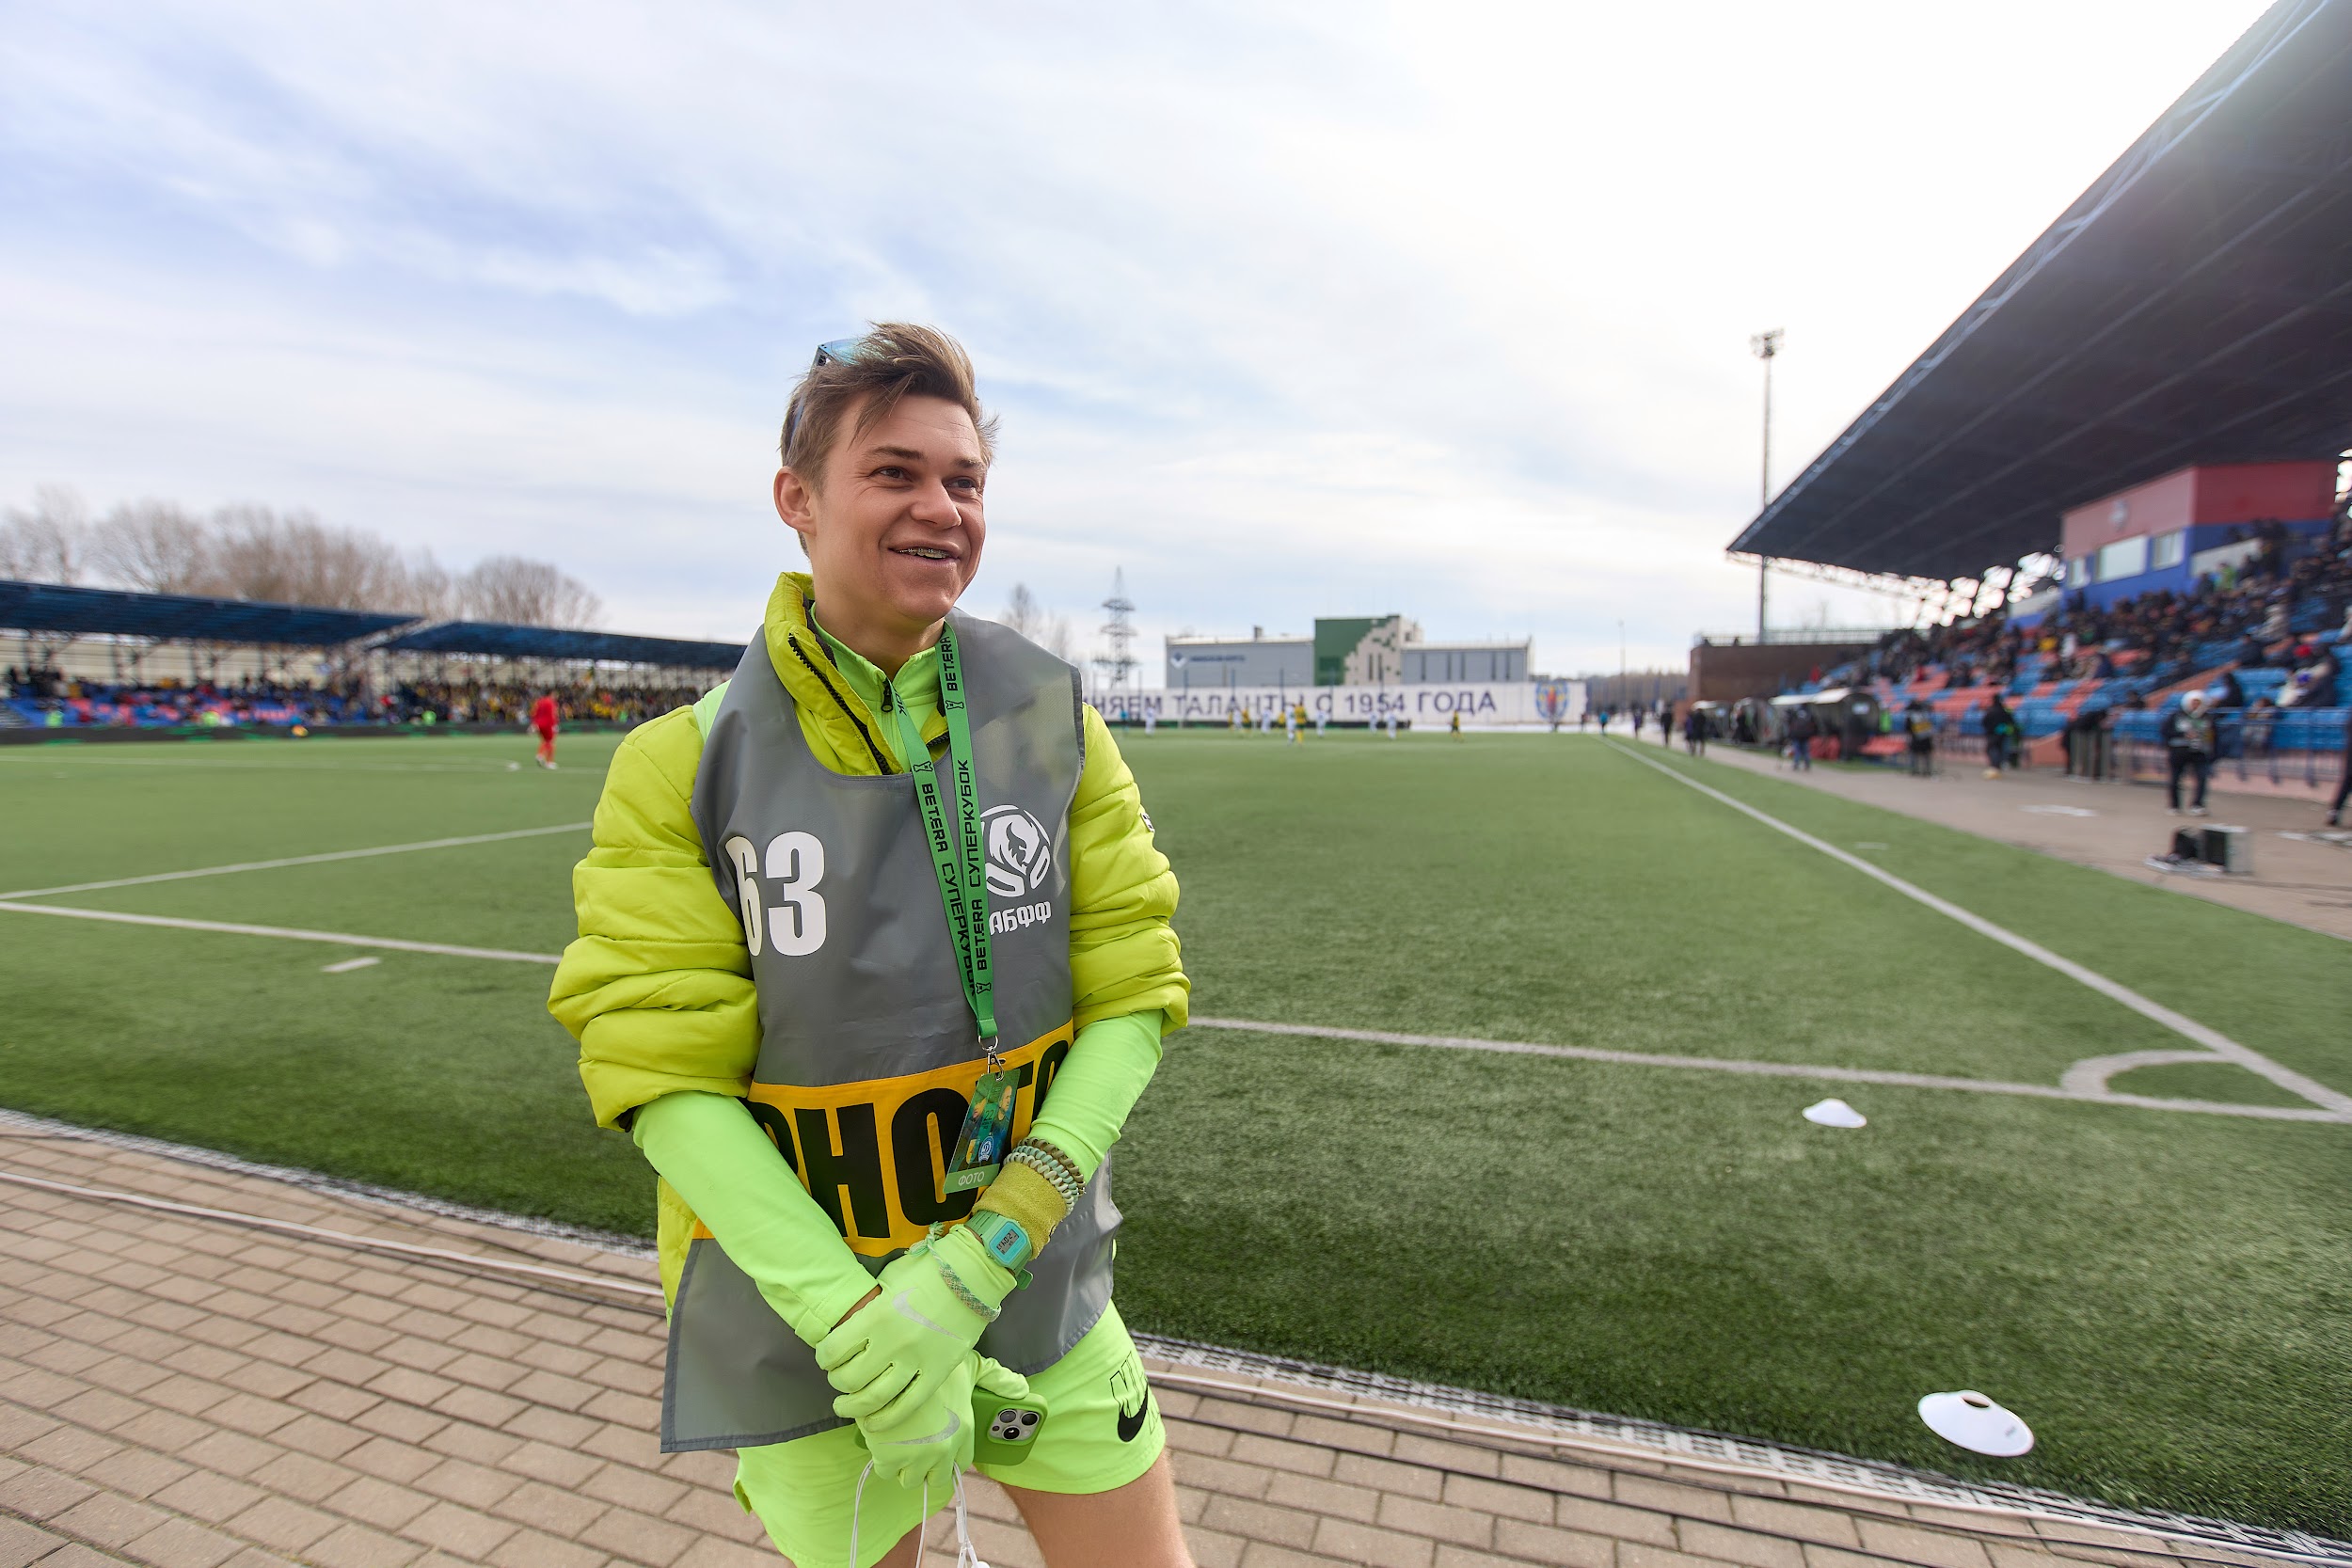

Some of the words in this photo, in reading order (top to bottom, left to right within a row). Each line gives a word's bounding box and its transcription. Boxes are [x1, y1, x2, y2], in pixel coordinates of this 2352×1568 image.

[1084, 694, 1163, 716] НЯЕМ
[1344, 693, 1406, 713] 1954
[1418, 690, 1497, 715] ГОДА
[957, 759, 981, 888] СУПЕРКУБОК
[724, 832, 827, 957] 63
[989, 901, 1052, 935] АБФФ
[958, 1171, 985, 1186] ФОТО
